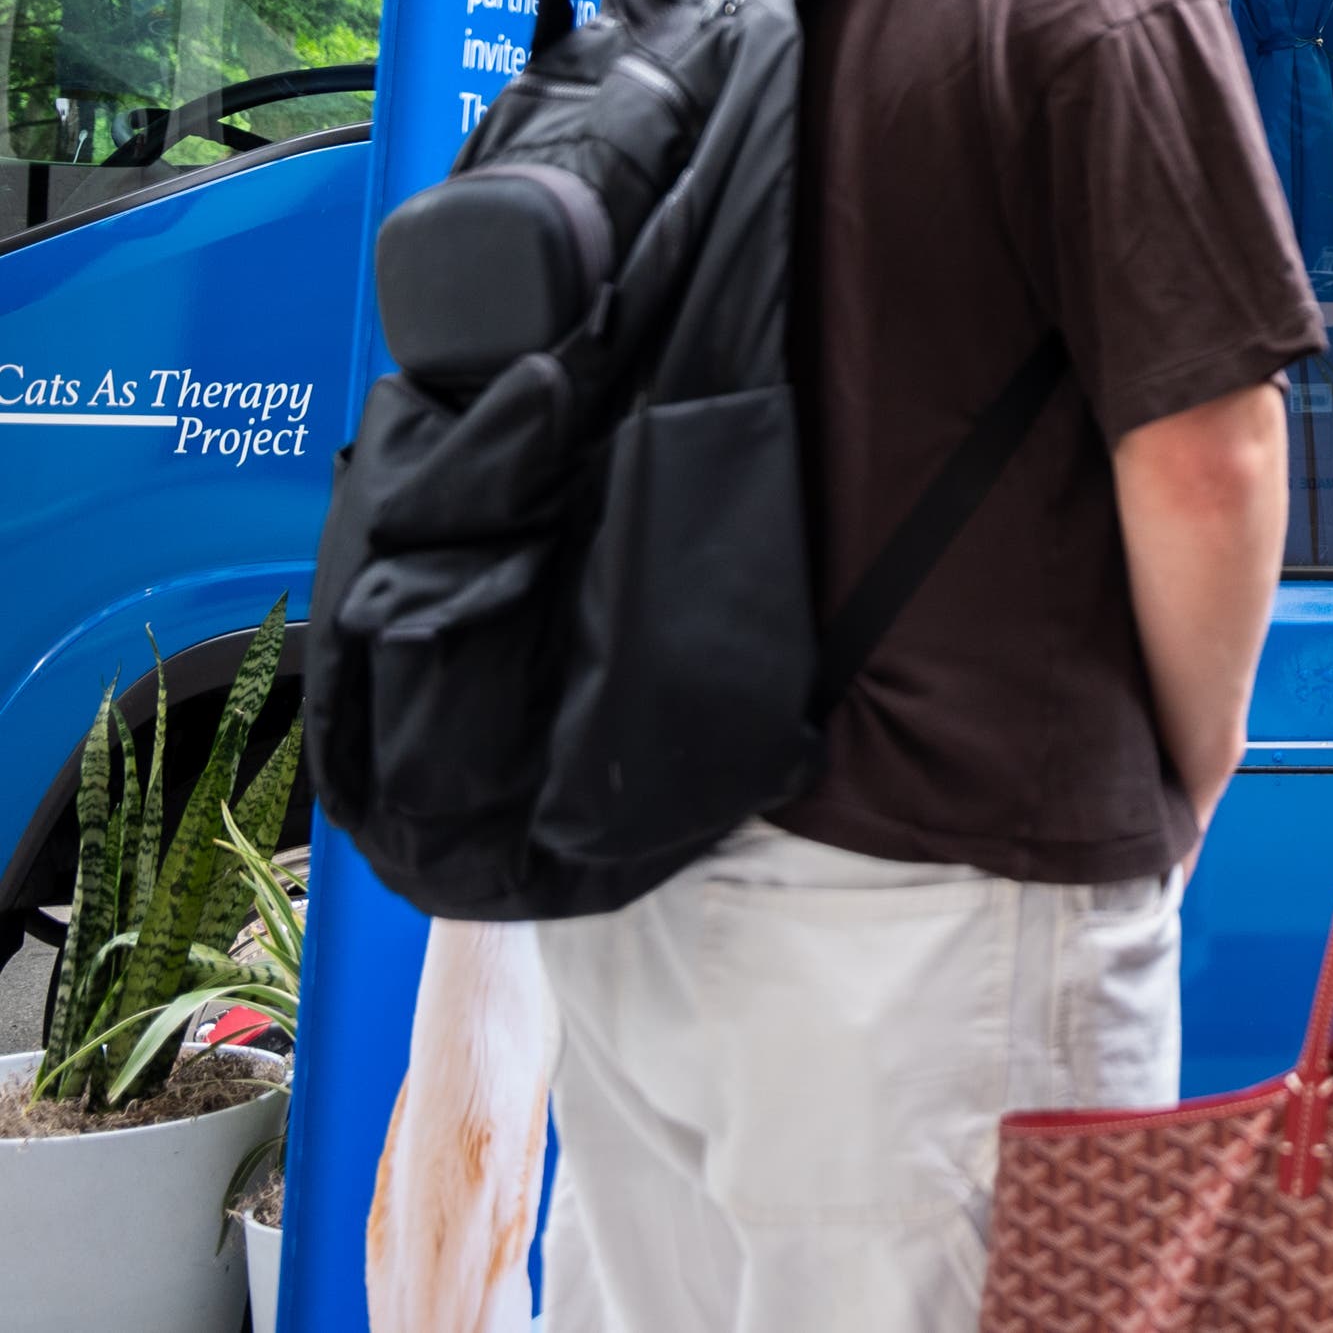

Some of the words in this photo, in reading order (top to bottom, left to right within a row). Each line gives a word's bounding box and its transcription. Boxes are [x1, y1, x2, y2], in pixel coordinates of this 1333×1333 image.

[0, 364, 81, 407] Cats
[87, 369, 138, 407] As
[150, 368, 313, 422] Therapy
[174, 416, 309, 467] Project
